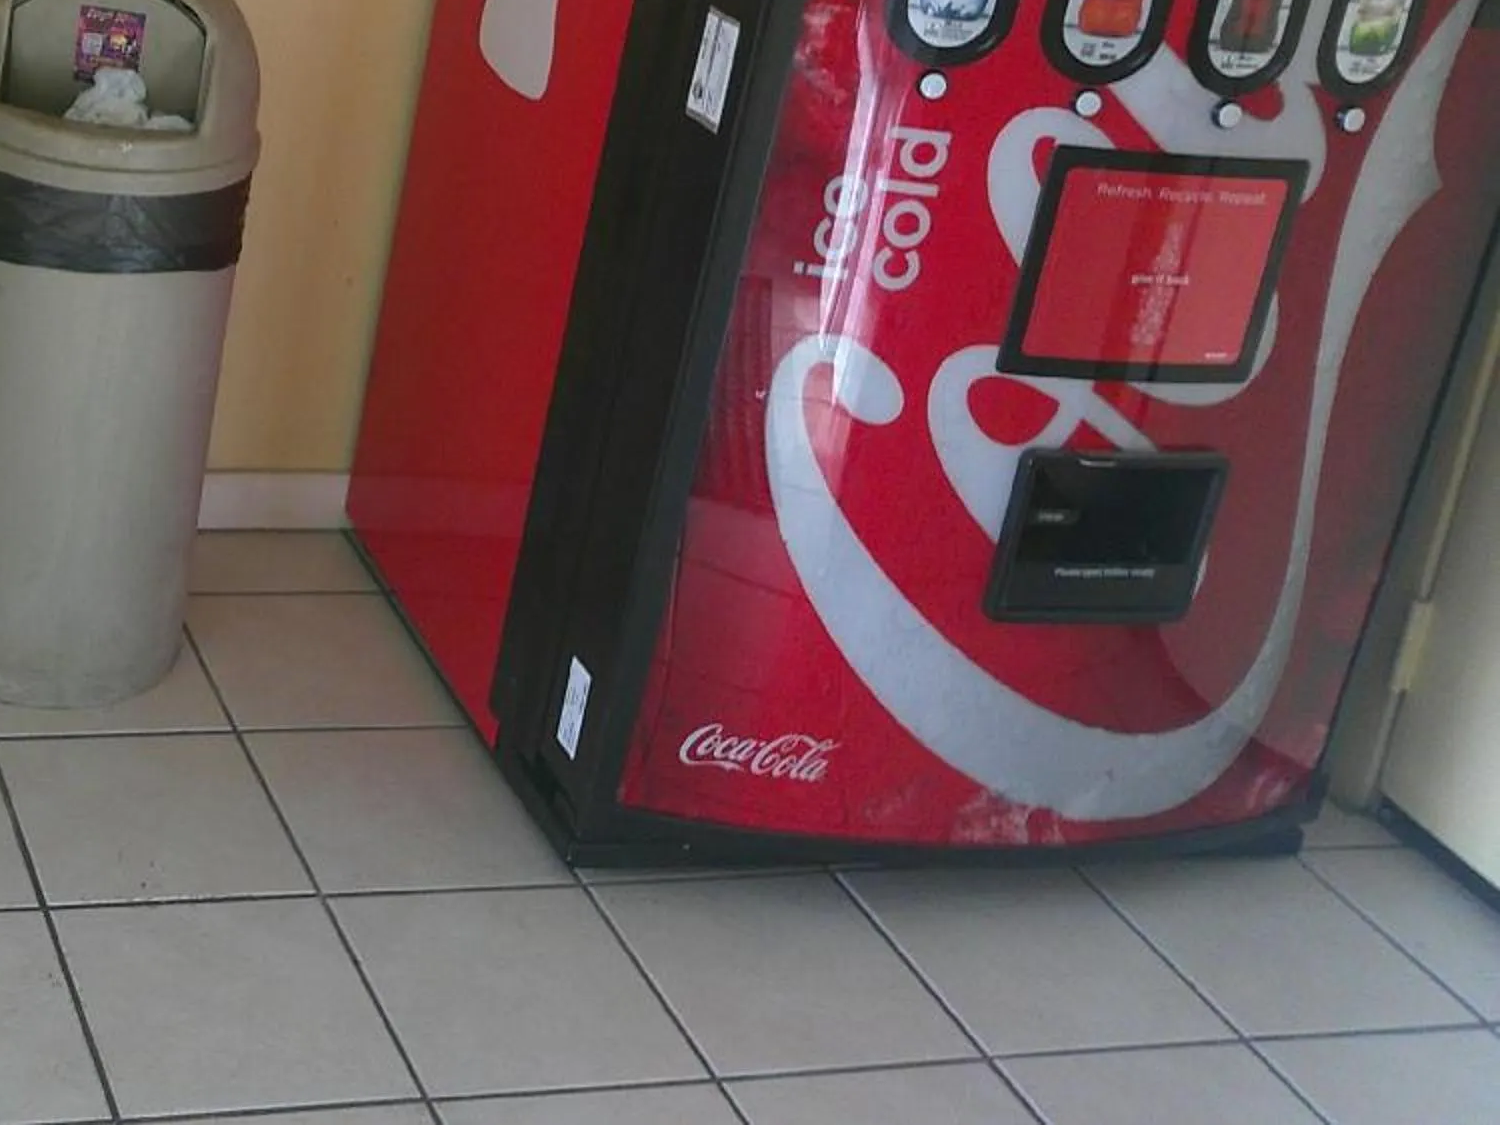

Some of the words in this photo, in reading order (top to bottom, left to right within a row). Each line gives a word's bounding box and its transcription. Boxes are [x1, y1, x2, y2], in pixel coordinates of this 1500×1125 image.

[794, 174, 869, 281] ice
[873, 126, 953, 292] cold
[678, 723, 842, 782] Coca-Cola
